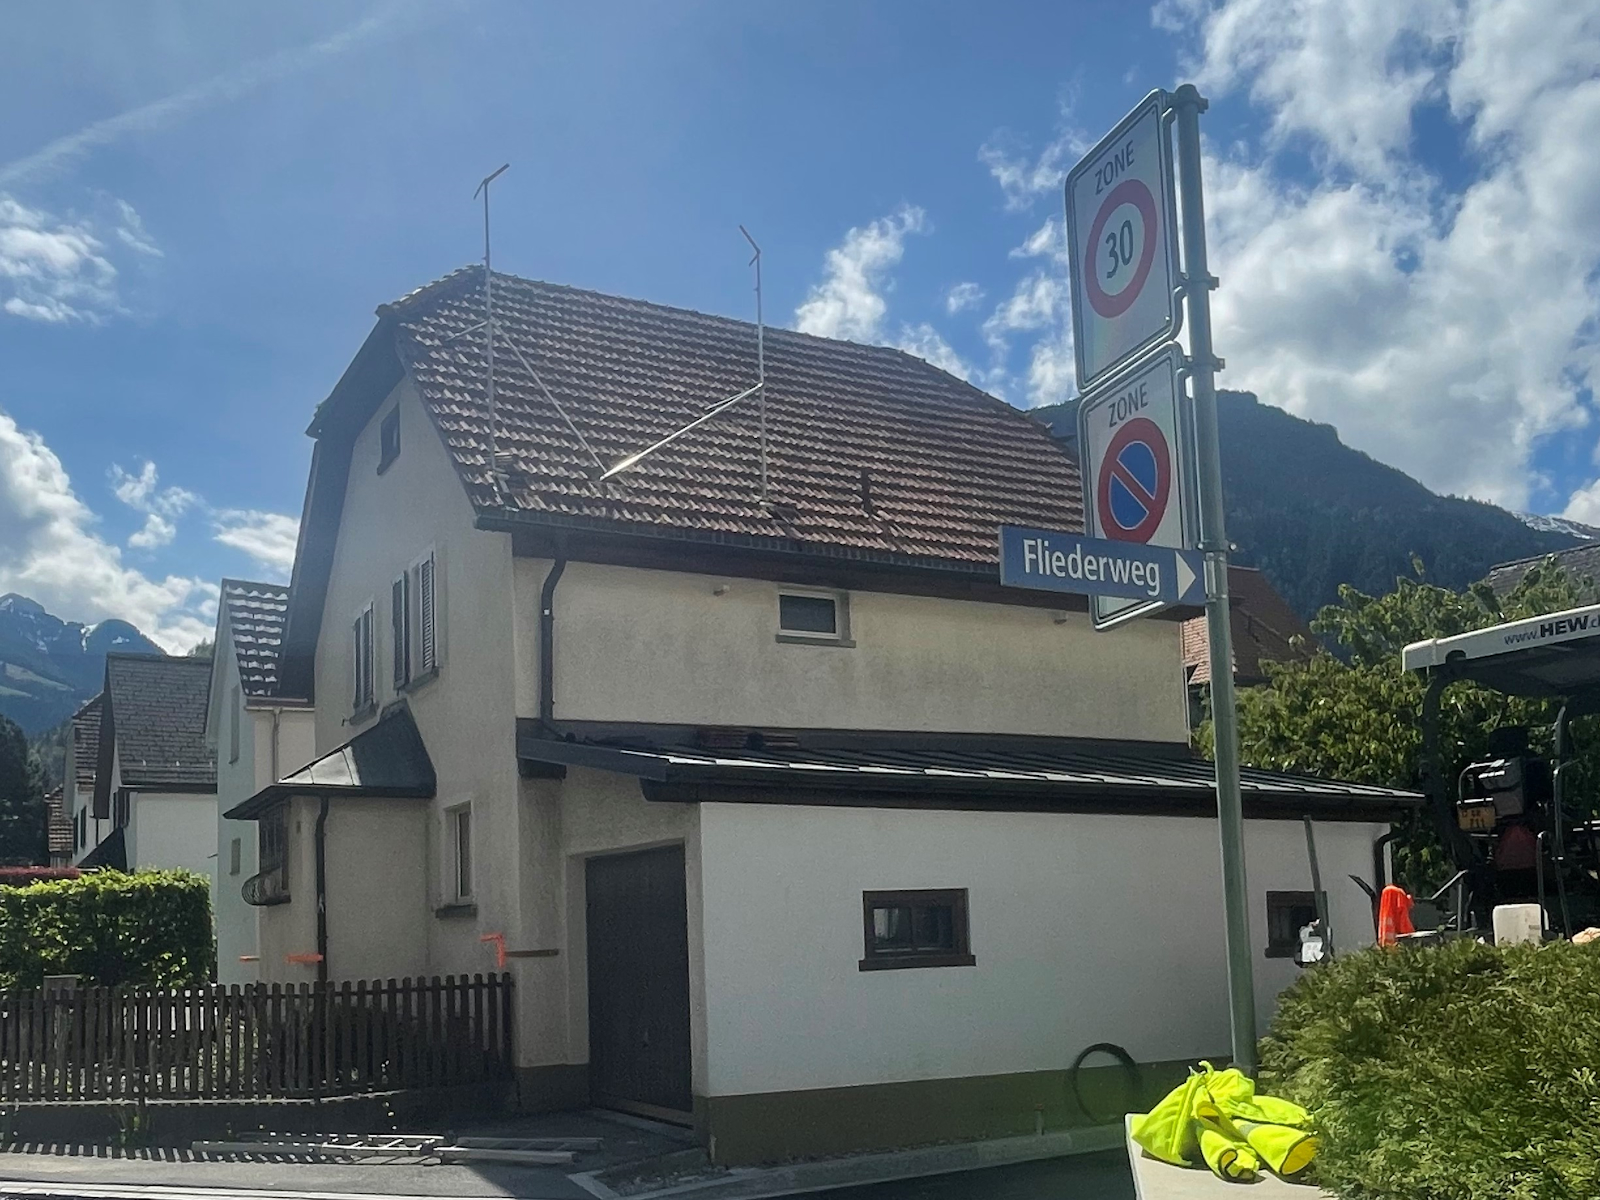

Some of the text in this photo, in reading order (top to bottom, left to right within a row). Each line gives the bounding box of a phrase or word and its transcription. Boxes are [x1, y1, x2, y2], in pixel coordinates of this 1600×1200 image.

[1094, 140, 1135, 195] ZONE
[1105, 219, 1133, 279] 30
[1108, 381, 1148, 428] ZONE
[1023, 538, 1161, 597] Fliederweg
